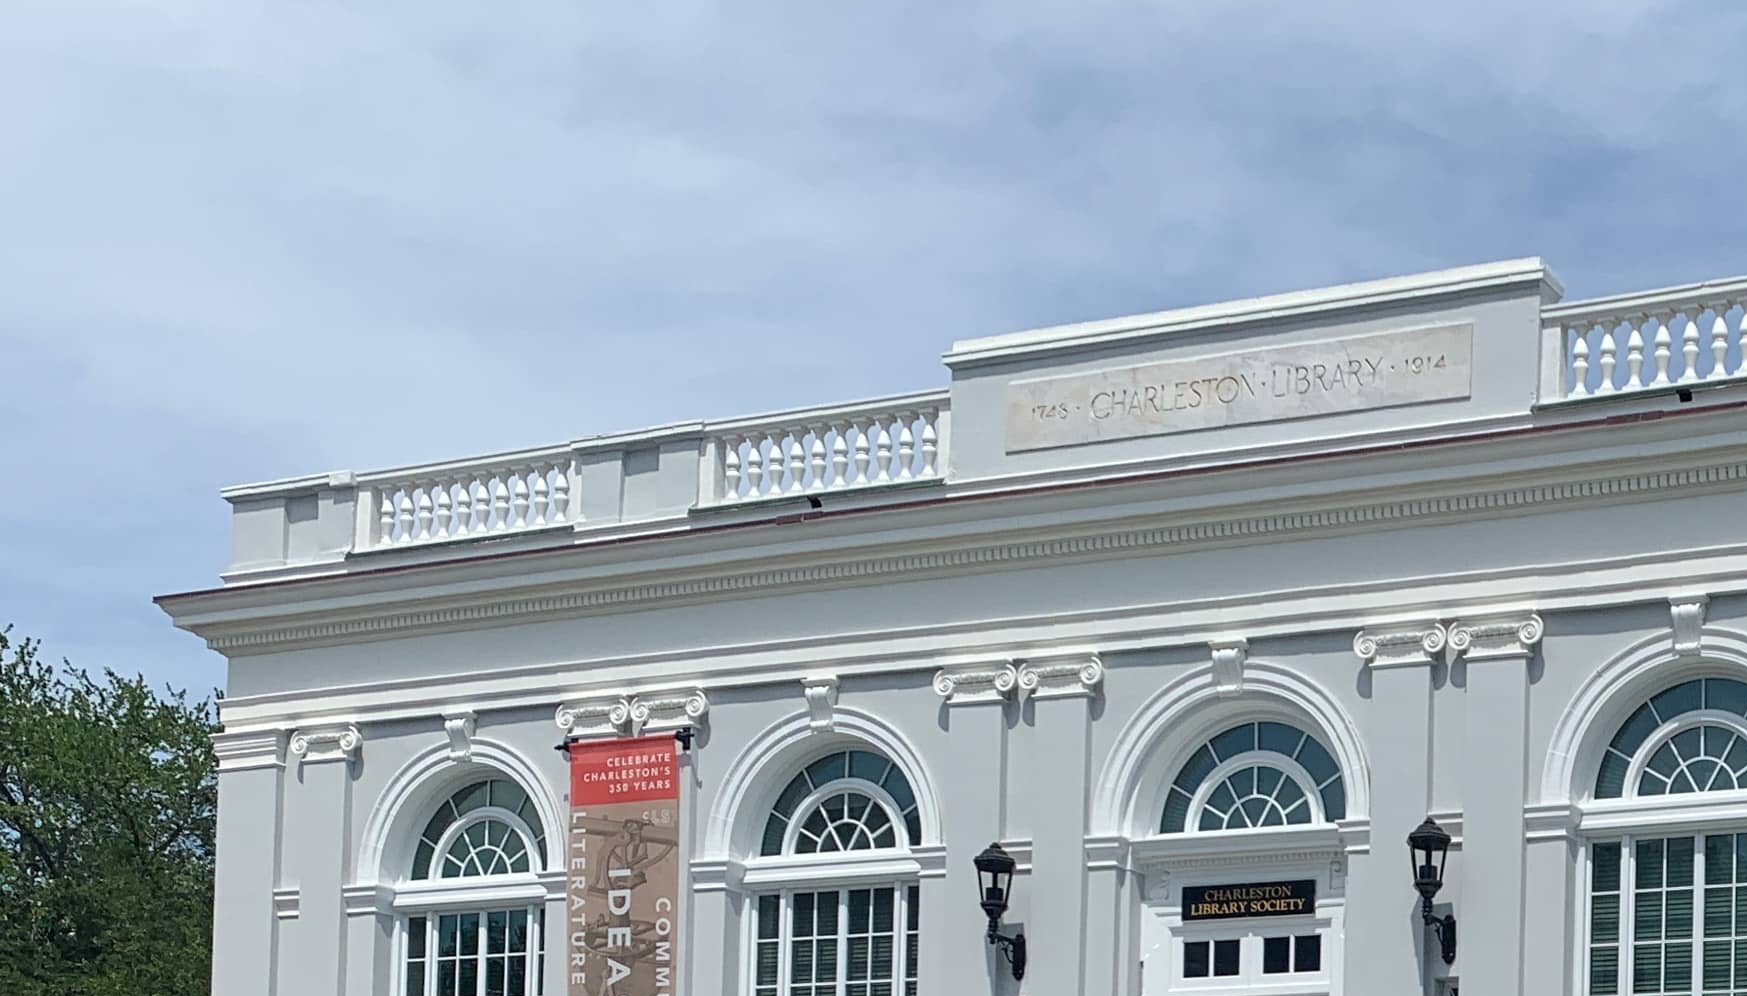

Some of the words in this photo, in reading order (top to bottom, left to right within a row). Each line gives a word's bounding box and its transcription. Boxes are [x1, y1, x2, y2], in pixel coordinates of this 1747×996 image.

[1091, 374, 1255, 420] CHARLESTON
[1271, 356, 1385, 398] LIBRARY
[1404, 354, 1447, 374] 1914
[606, 753, 671, 768] CELEBRATE
[583, 767, 671, 783] CHARLESTON'S
[608, 783, 629, 793] 350
[633, 781, 671, 791] YEARS
[571, 811, 587, 985] LITERATURE
[1204, 884, 1292, 901] CHARLESTON
[1191, 901, 1248, 916] LIBRARY
[1250, 898, 1305, 912] SOCIETY
